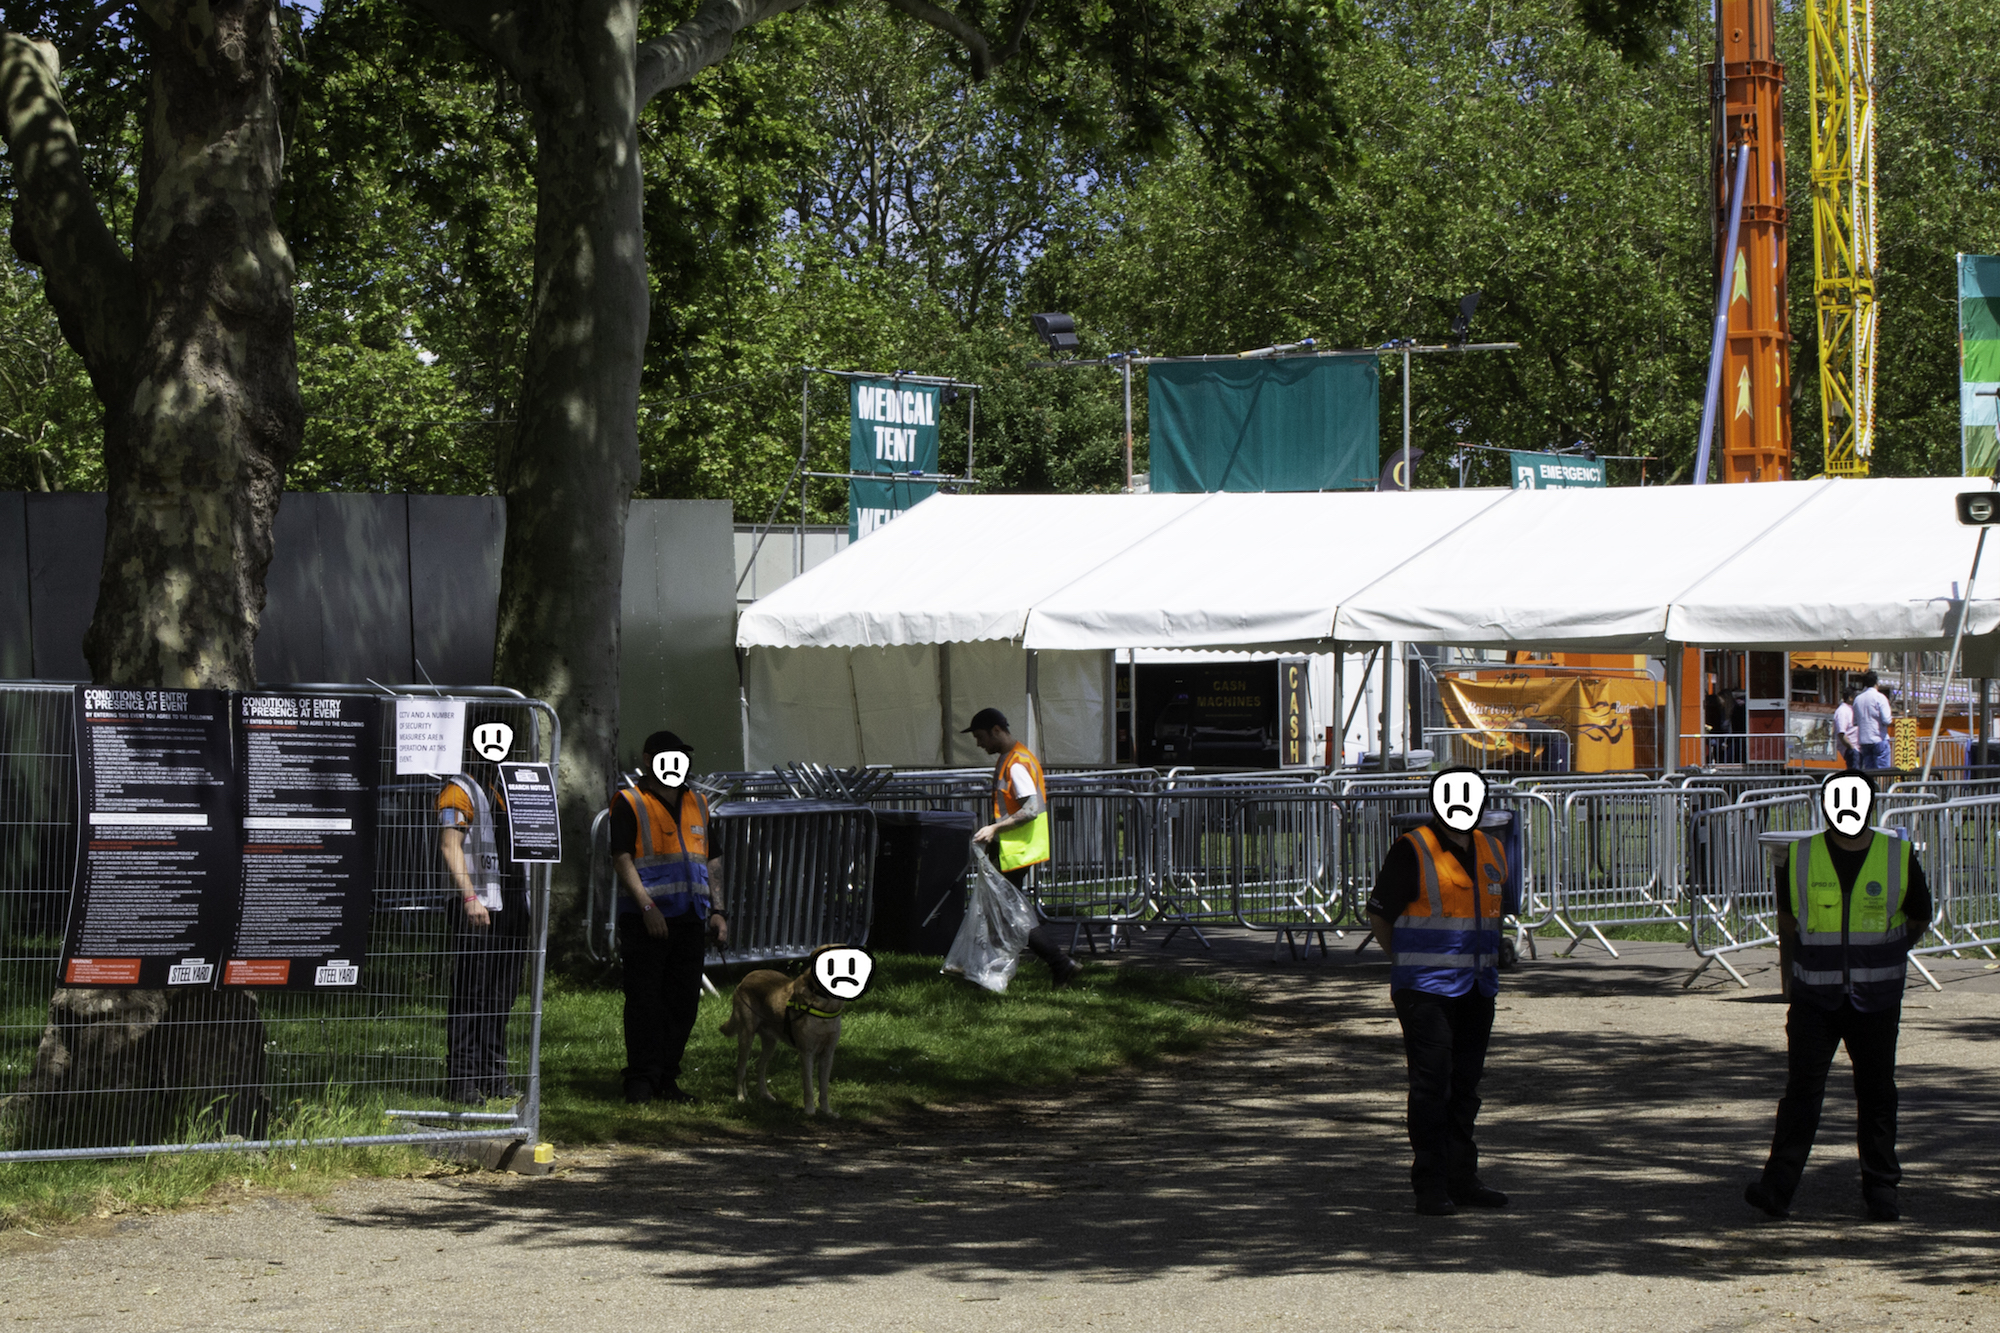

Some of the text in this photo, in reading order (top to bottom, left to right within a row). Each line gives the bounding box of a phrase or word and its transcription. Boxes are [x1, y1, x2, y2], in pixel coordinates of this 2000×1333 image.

[858, 386, 935, 426] MEDICAL
[874, 426, 917, 462] TENT
[1540, 464, 1602, 482] EMERGENCY
[1213, 680, 1247, 692] CASH
[84, 690, 188, 702] CONDITIONS OF ENTRY
[242, 697, 341, 709] CONDITIONS OF ENTRY
[1197, 696, 1262, 708] MACHINES
[85, 700, 188, 711] & PRESENCE AT EVENT
[242, 707, 341, 719] & PRESENCE AT EVENT
[1289, 666, 1299, 763] CASH
[172, 967, 191, 982] STEEL
[192, 966, 210, 981] YARD
[318, 968, 355, 984] STEEL YARD
